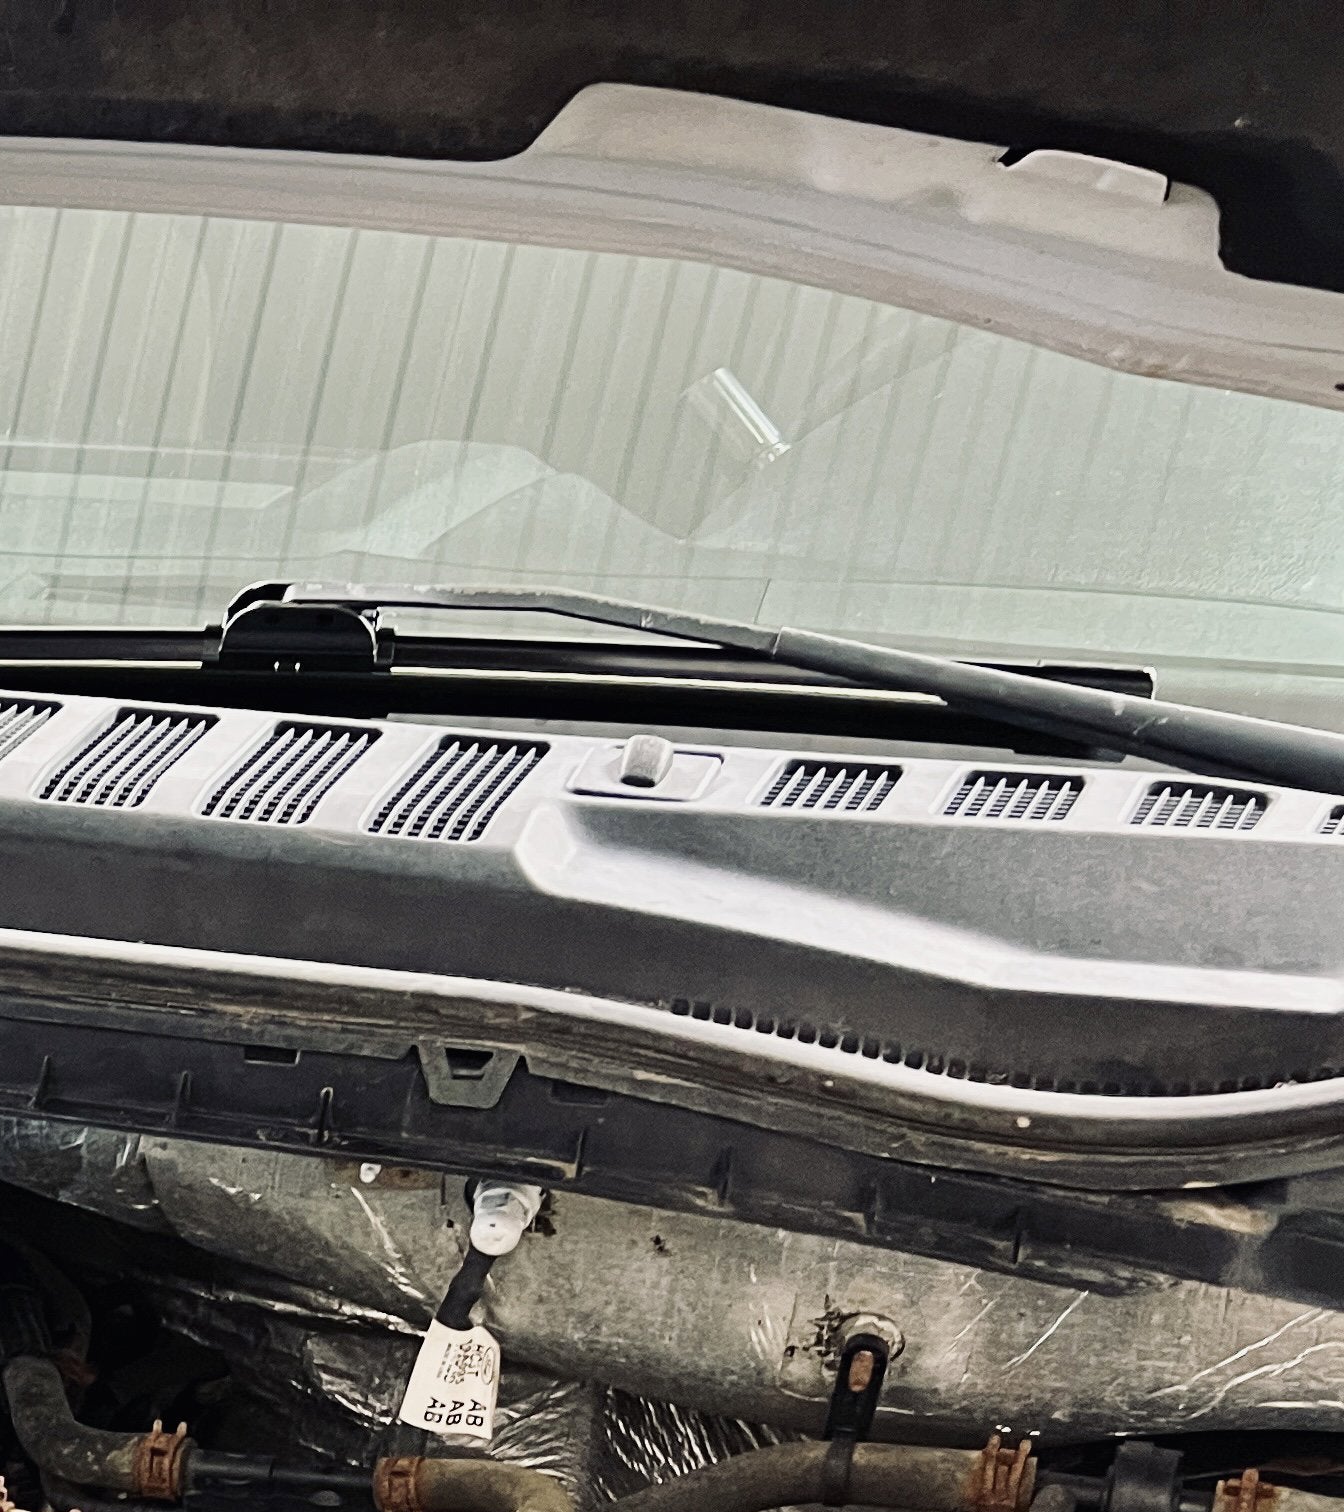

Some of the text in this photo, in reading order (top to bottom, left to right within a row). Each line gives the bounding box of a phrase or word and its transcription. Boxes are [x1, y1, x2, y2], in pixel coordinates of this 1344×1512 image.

[423, 1396, 446, 1424] AB
[445, 1399, 465, 1426] AB
[465, 1398, 487, 1428] AB
